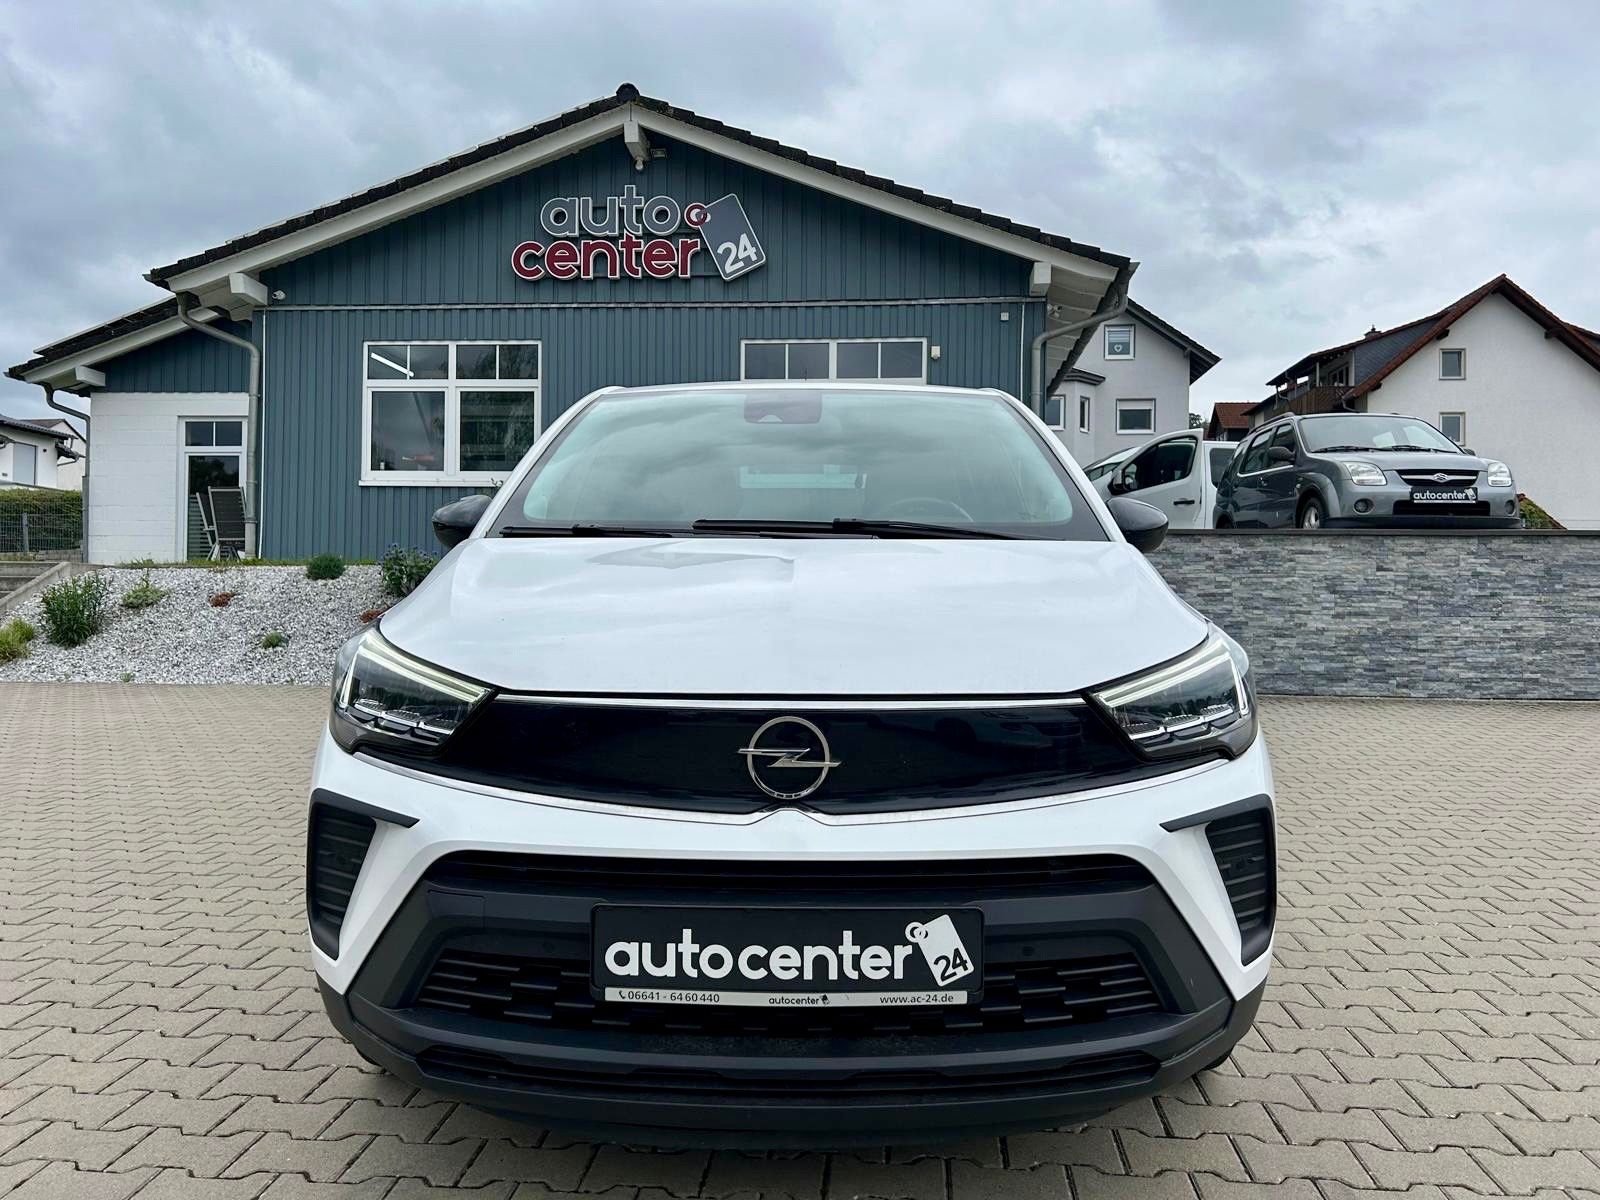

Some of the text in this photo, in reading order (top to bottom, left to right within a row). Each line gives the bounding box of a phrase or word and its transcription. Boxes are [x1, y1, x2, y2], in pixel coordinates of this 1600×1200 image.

[540, 185, 680, 237] auto
[511, 231, 700, 280] center
[717, 233, 758, 274] 24
[1413, 490, 1466, 500] autocenter
[605, 928, 913, 980] autocenter
[933, 947, 969, 983] 24
[628, 990, 660, 1001] 06641
[768, 995, 819, 1005] autocenter
[880, 994, 954, 1004] www.ac-24.de
